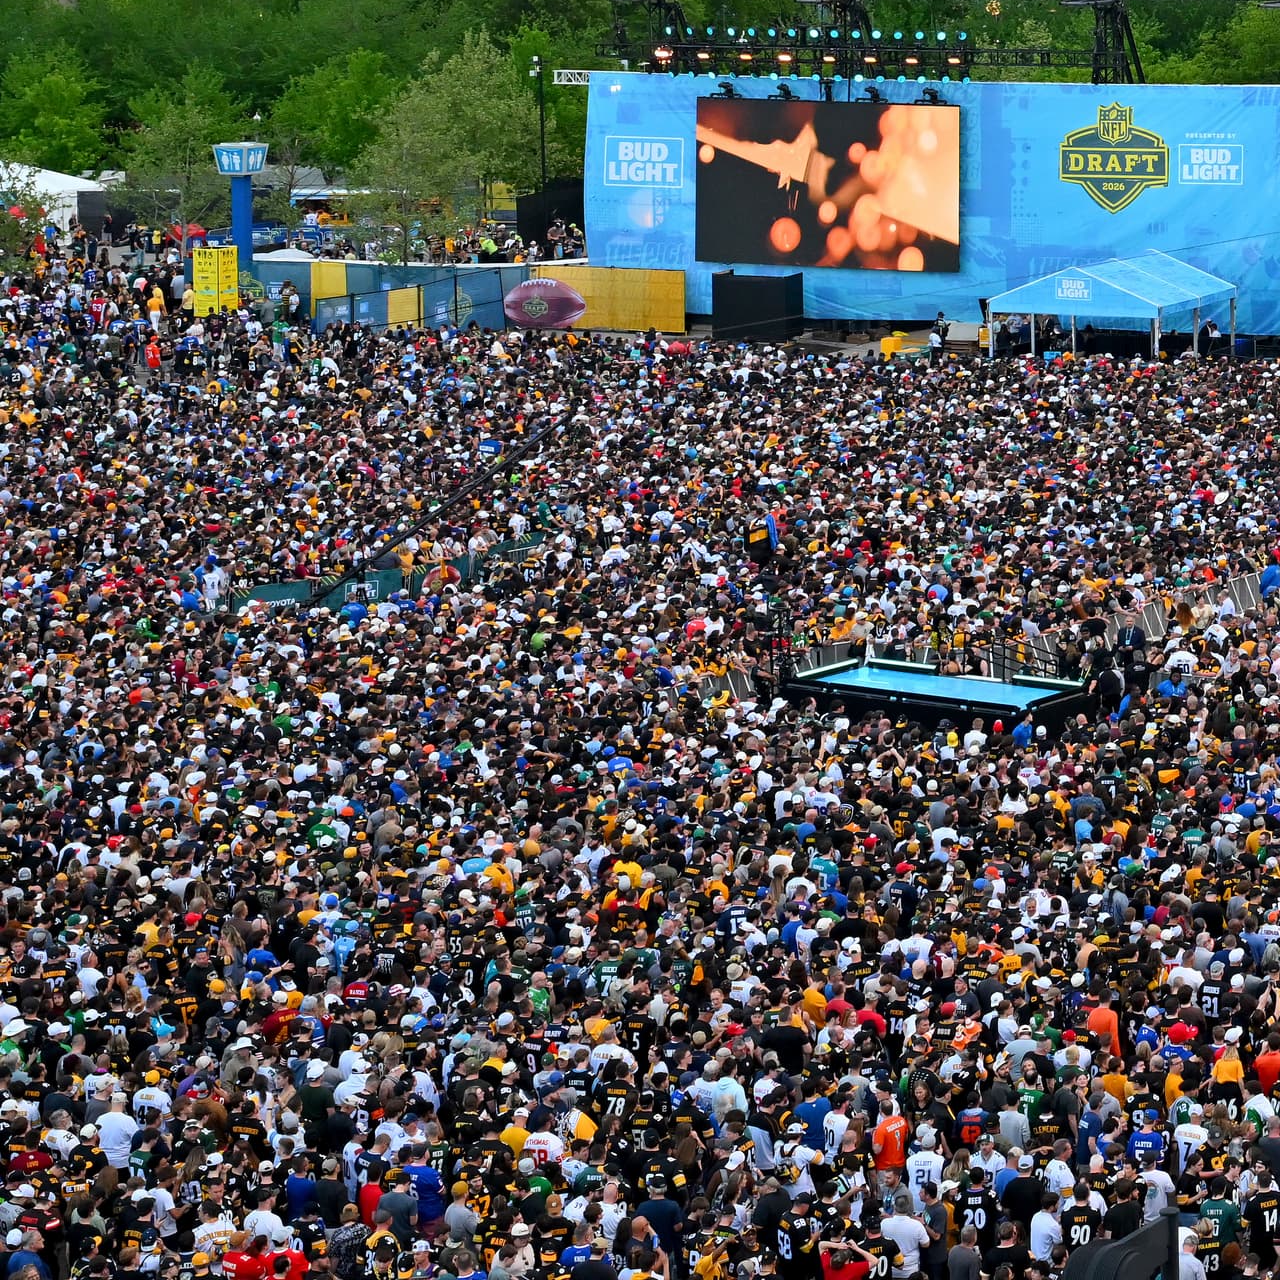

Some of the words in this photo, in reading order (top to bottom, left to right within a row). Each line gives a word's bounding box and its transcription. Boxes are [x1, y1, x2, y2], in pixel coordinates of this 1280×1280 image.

[1101, 122, 1124, 138] NFL
[619, 142, 669, 162] BUD
[1190, 148, 1231, 164] BUD
[1069, 153, 1158, 172] DRAFT
[608, 162, 678, 183] LIGHT
[1182, 164, 1239, 181] LIGHT
[1102, 182, 1126, 191] 2026
[1062, 279, 1085, 289] BUD
[1057, 287, 1089, 299] LIGHT
[449, 936, 462, 953] 55
[1202, 997, 1219, 1018] 21
[544, 1029, 562, 1038] BRADY
[890, 1017, 903, 1035] 14
[527, 1054, 536, 1073] 9
[607, 1096, 626, 1115] 78
[529, 1138, 549, 1146] THOMAS
[1182, 1142, 1192, 1156] 7
[915, 1168, 932, 1183] 21
[967, 1196, 982, 1205] REED
[963, 1208, 986, 1229] 20
[1073, 1215, 1089, 1223] WATT
[1206, 1208, 1223, 1216] SMITH
[1263, 1209, 1278, 1231] 14
[793, 1217, 806, 1227] 58
[777, 1228, 793, 1256] 58
[1070, 1224, 1090, 1245] 90
